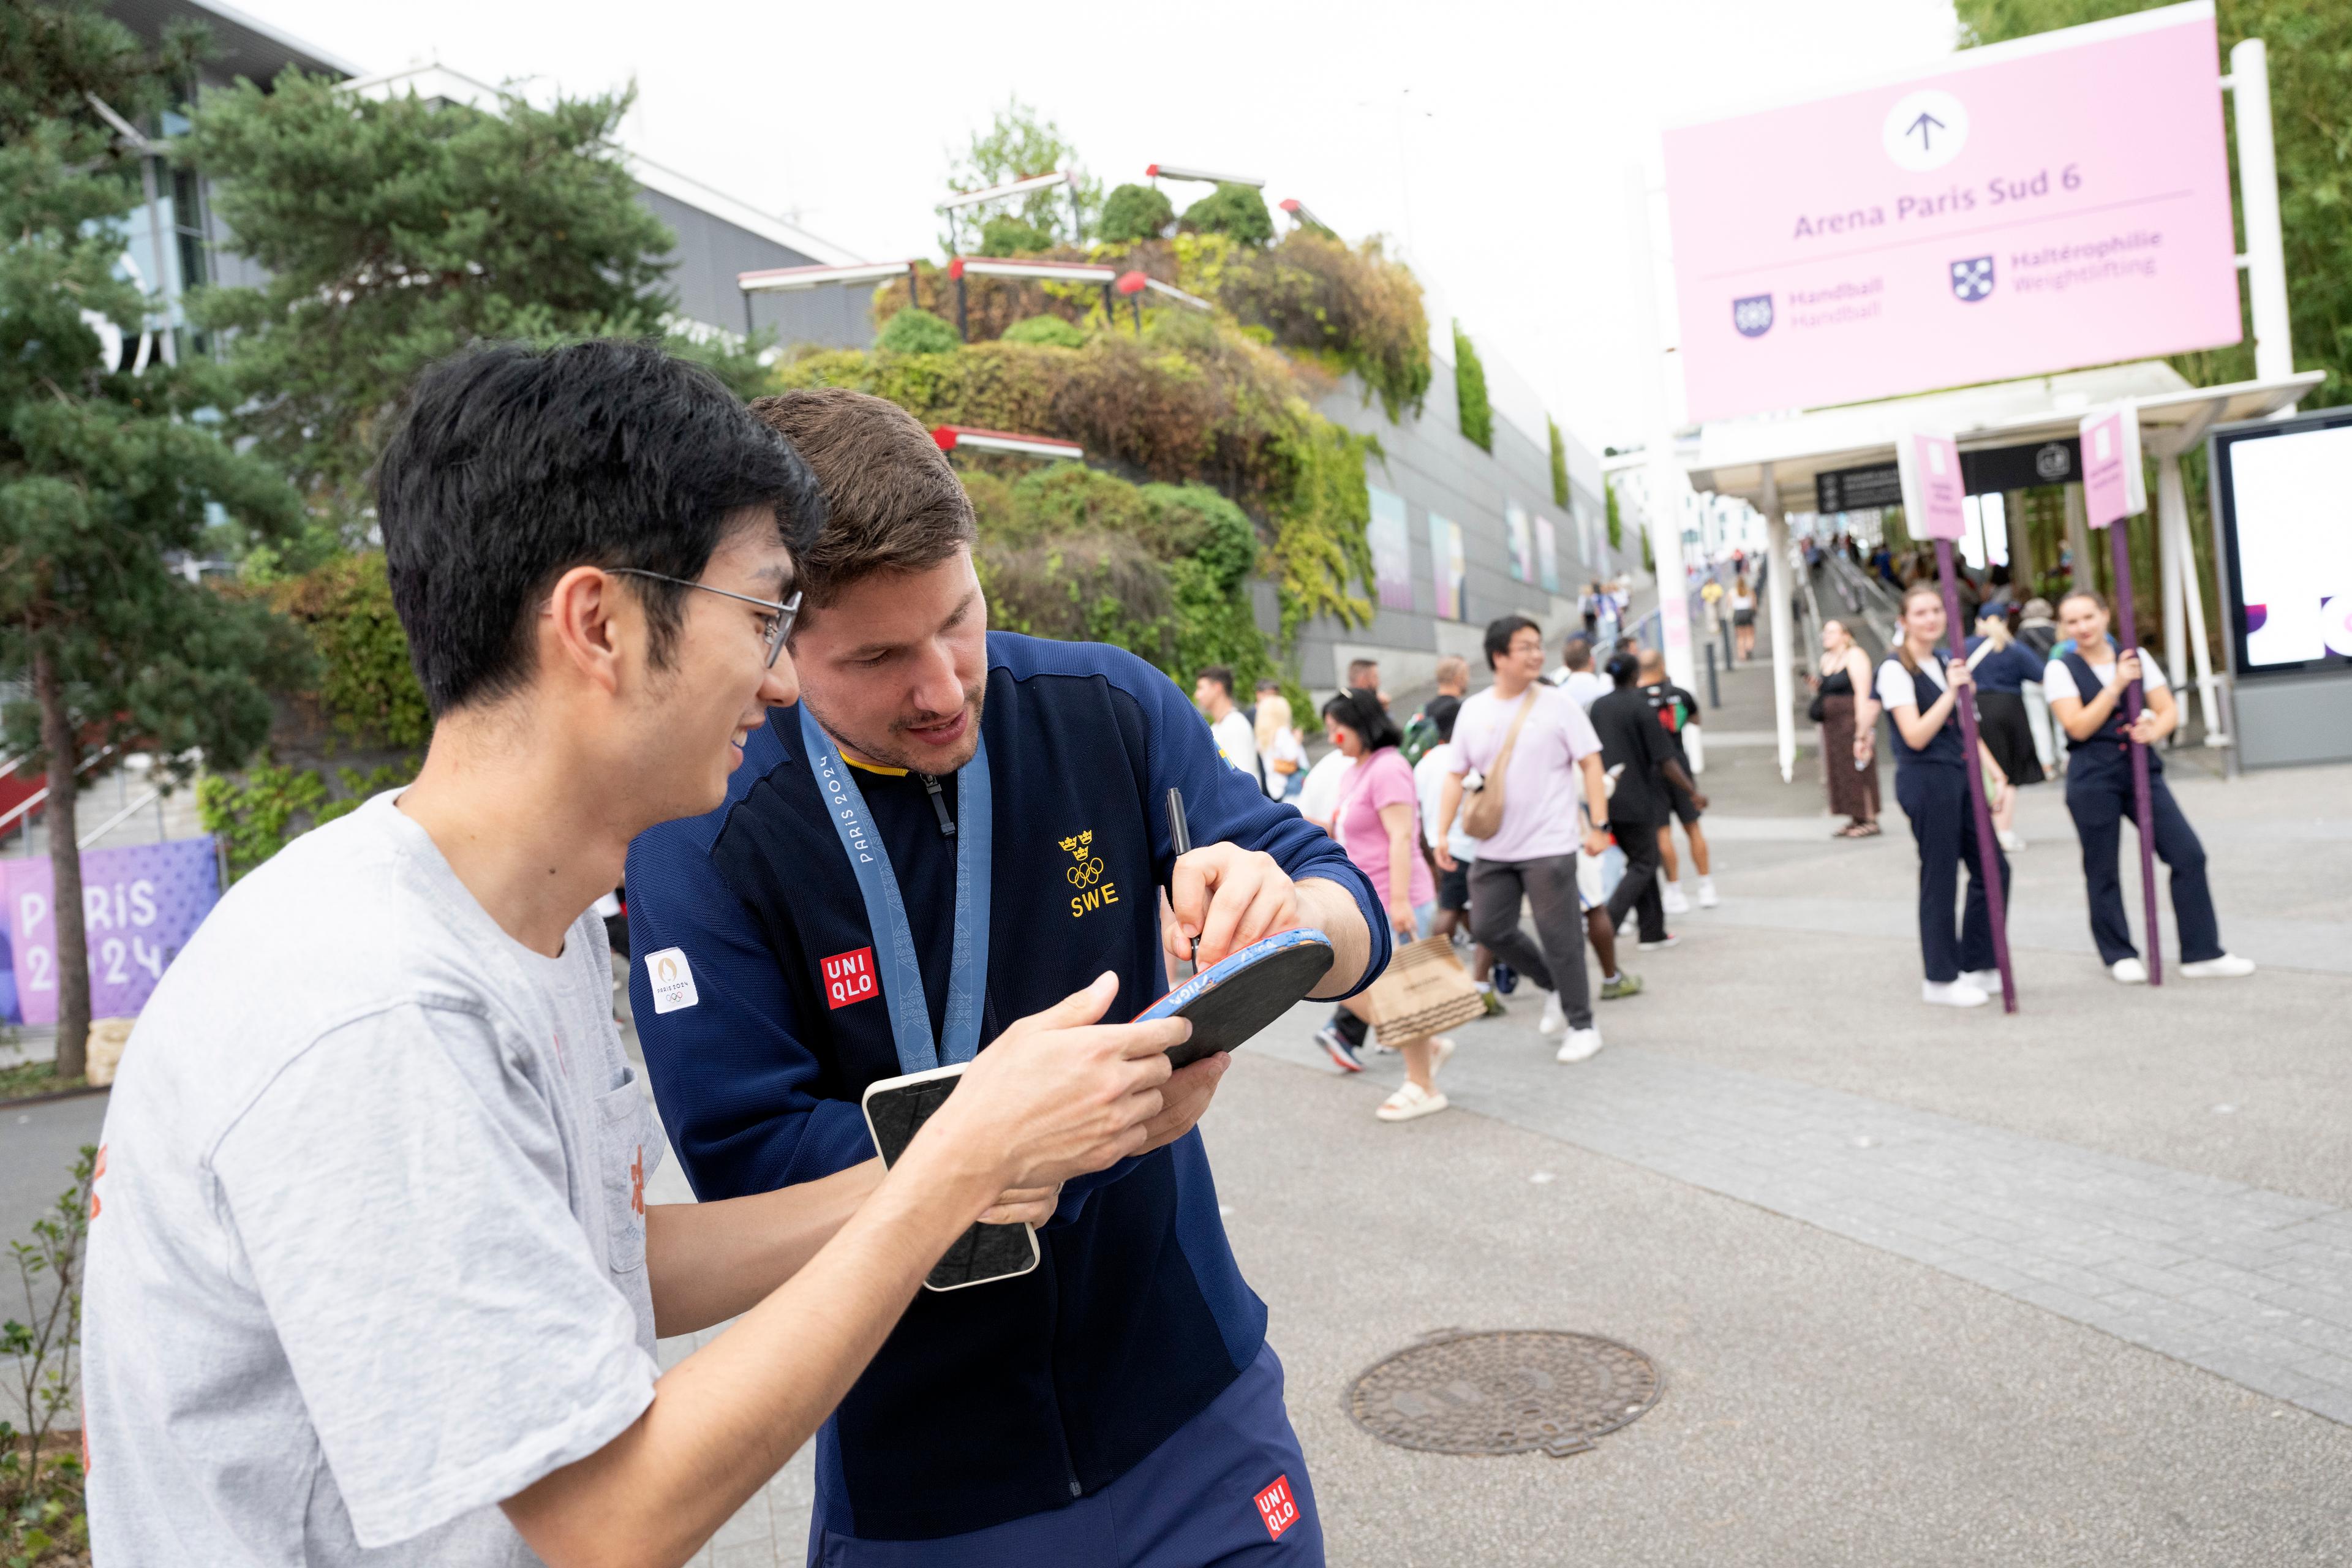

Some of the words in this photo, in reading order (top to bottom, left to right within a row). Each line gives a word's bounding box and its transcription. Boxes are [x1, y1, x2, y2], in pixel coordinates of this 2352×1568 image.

[1793, 206, 1885, 240] Arena
[1898, 185, 1976, 221] Paris
[1988, 169, 2048, 206] Sud
[2060, 163, 2081, 191] 6
[1789, 277, 1884, 306] Handball
[2011, 256, 2157, 295] Weightlifting
[820, 756, 848, 804] 2024
[1071, 883, 1118, 917] SWE
[26, 936, 161, 991] 224
[827, 954, 864, 979] UNI
[832, 974, 872, 1001] QLO
[1259, 1485, 1286, 1513] UNI
[1268, 1501, 1294, 1531] QLO
